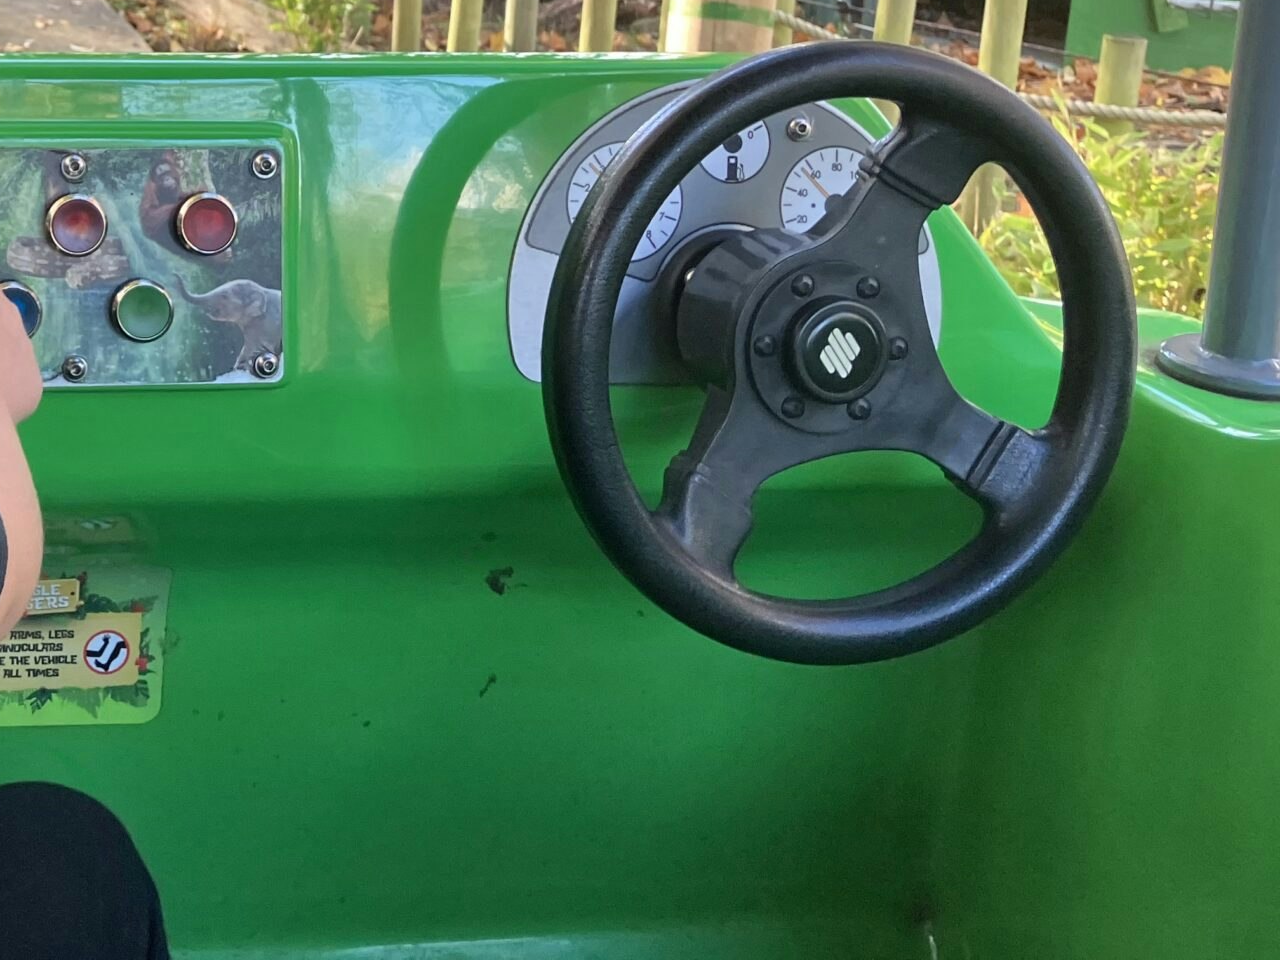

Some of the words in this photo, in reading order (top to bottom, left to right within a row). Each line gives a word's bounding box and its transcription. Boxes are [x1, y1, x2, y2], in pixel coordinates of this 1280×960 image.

[831, 163, 843, 172] 80
[811, 170, 821, 179] 60
[797, 188, 808, 197] 40
[796, 215, 807, 223] 20
[10, 630, 45, 640] ARMS,
[48, 629, 75, 639] LEGS
[9, 655, 30, 665] THE
[34, 654, 77, 665] VEHICLE
[3, 668, 22, 678] ALL
[25, 668, 59, 678] TIMES
